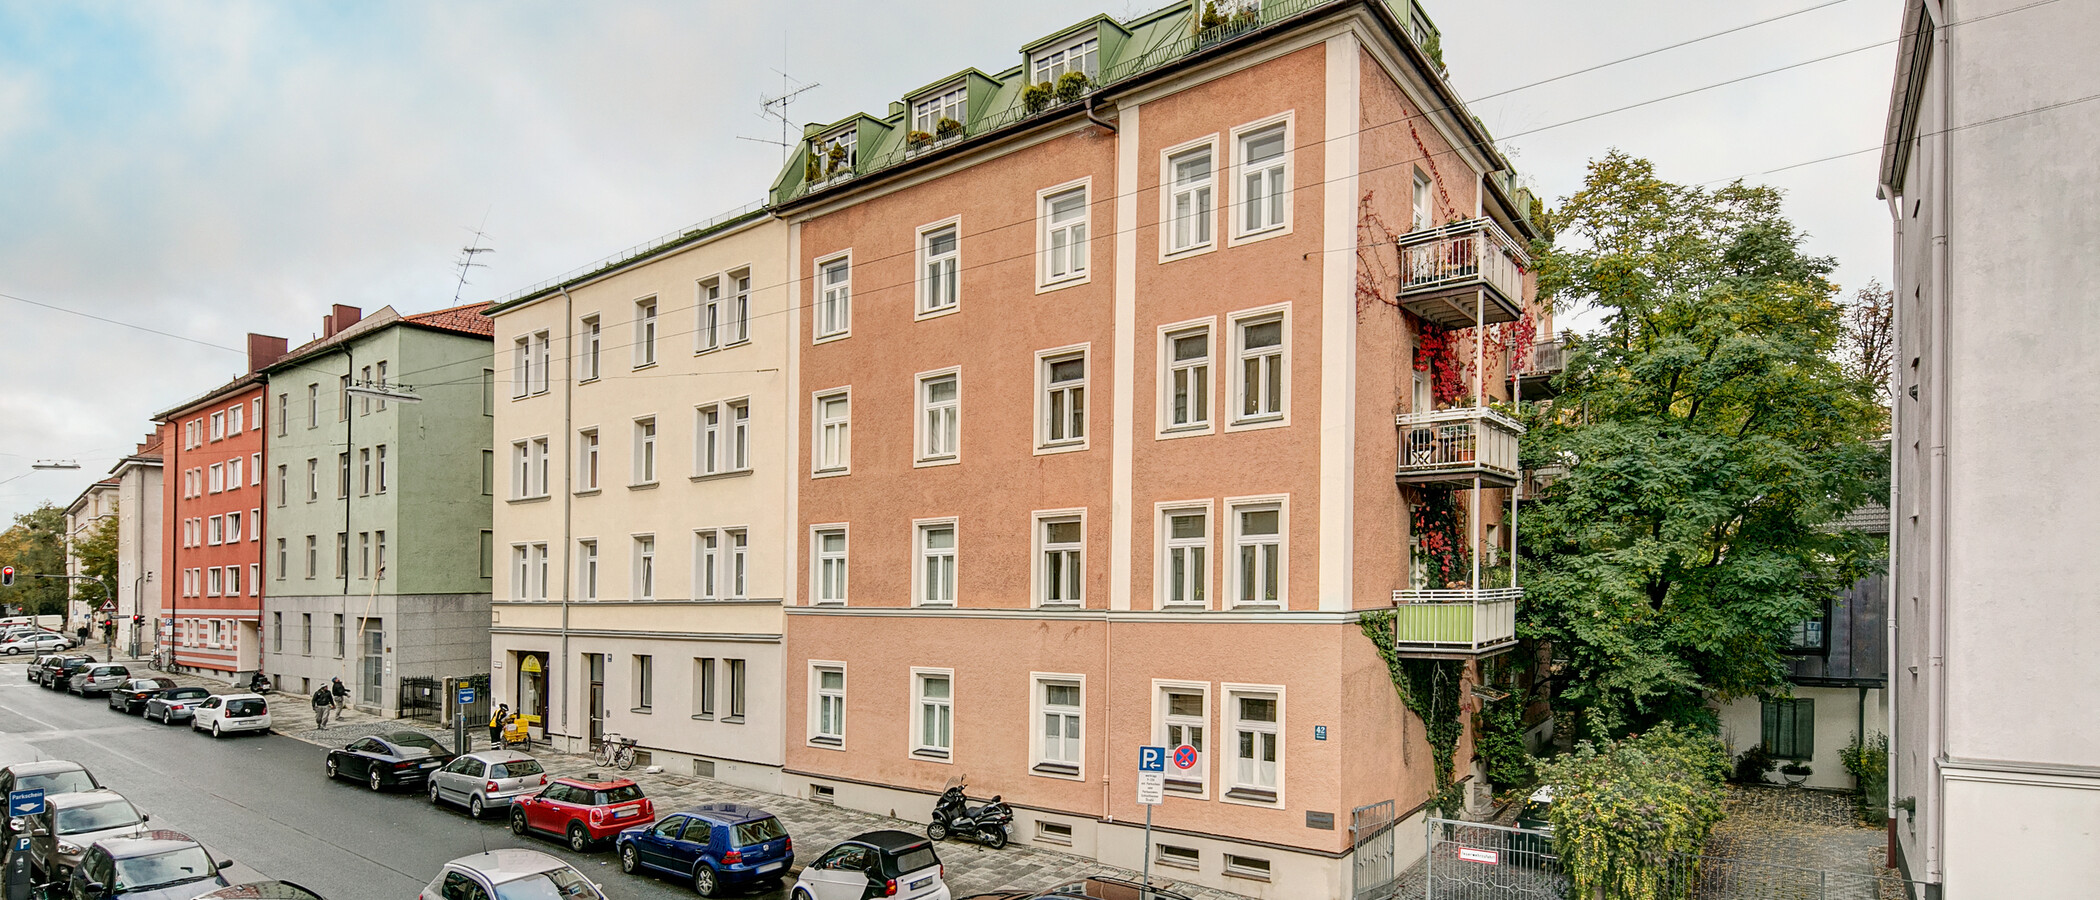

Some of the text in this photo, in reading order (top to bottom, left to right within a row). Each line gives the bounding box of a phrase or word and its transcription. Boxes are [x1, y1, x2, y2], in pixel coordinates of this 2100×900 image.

[1316, 726, 1325, 734] 42
[1142, 749, 1157, 768] P
[12, 792, 42, 800] Parkschein
[20, 838, 30, 849] P
